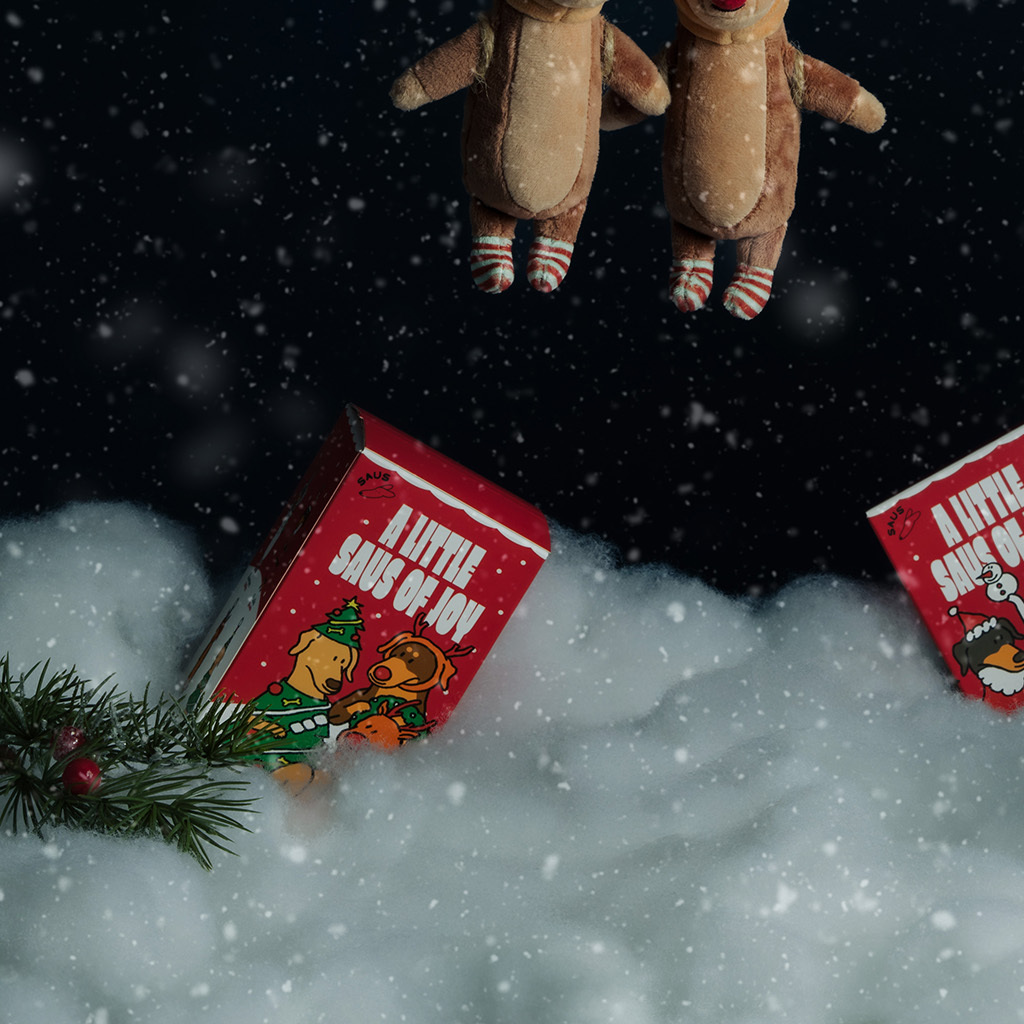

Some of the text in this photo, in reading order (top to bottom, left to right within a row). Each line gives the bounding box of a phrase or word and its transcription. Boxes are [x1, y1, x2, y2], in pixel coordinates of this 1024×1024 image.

[357, 471, 391, 486] SAUS
[887, 506, 904, 536] SAUS
[931, 503, 963, 548] A
[378, 503, 487, 590] A LITTLE
[328, 533, 486, 643] SAUS OF JOY
